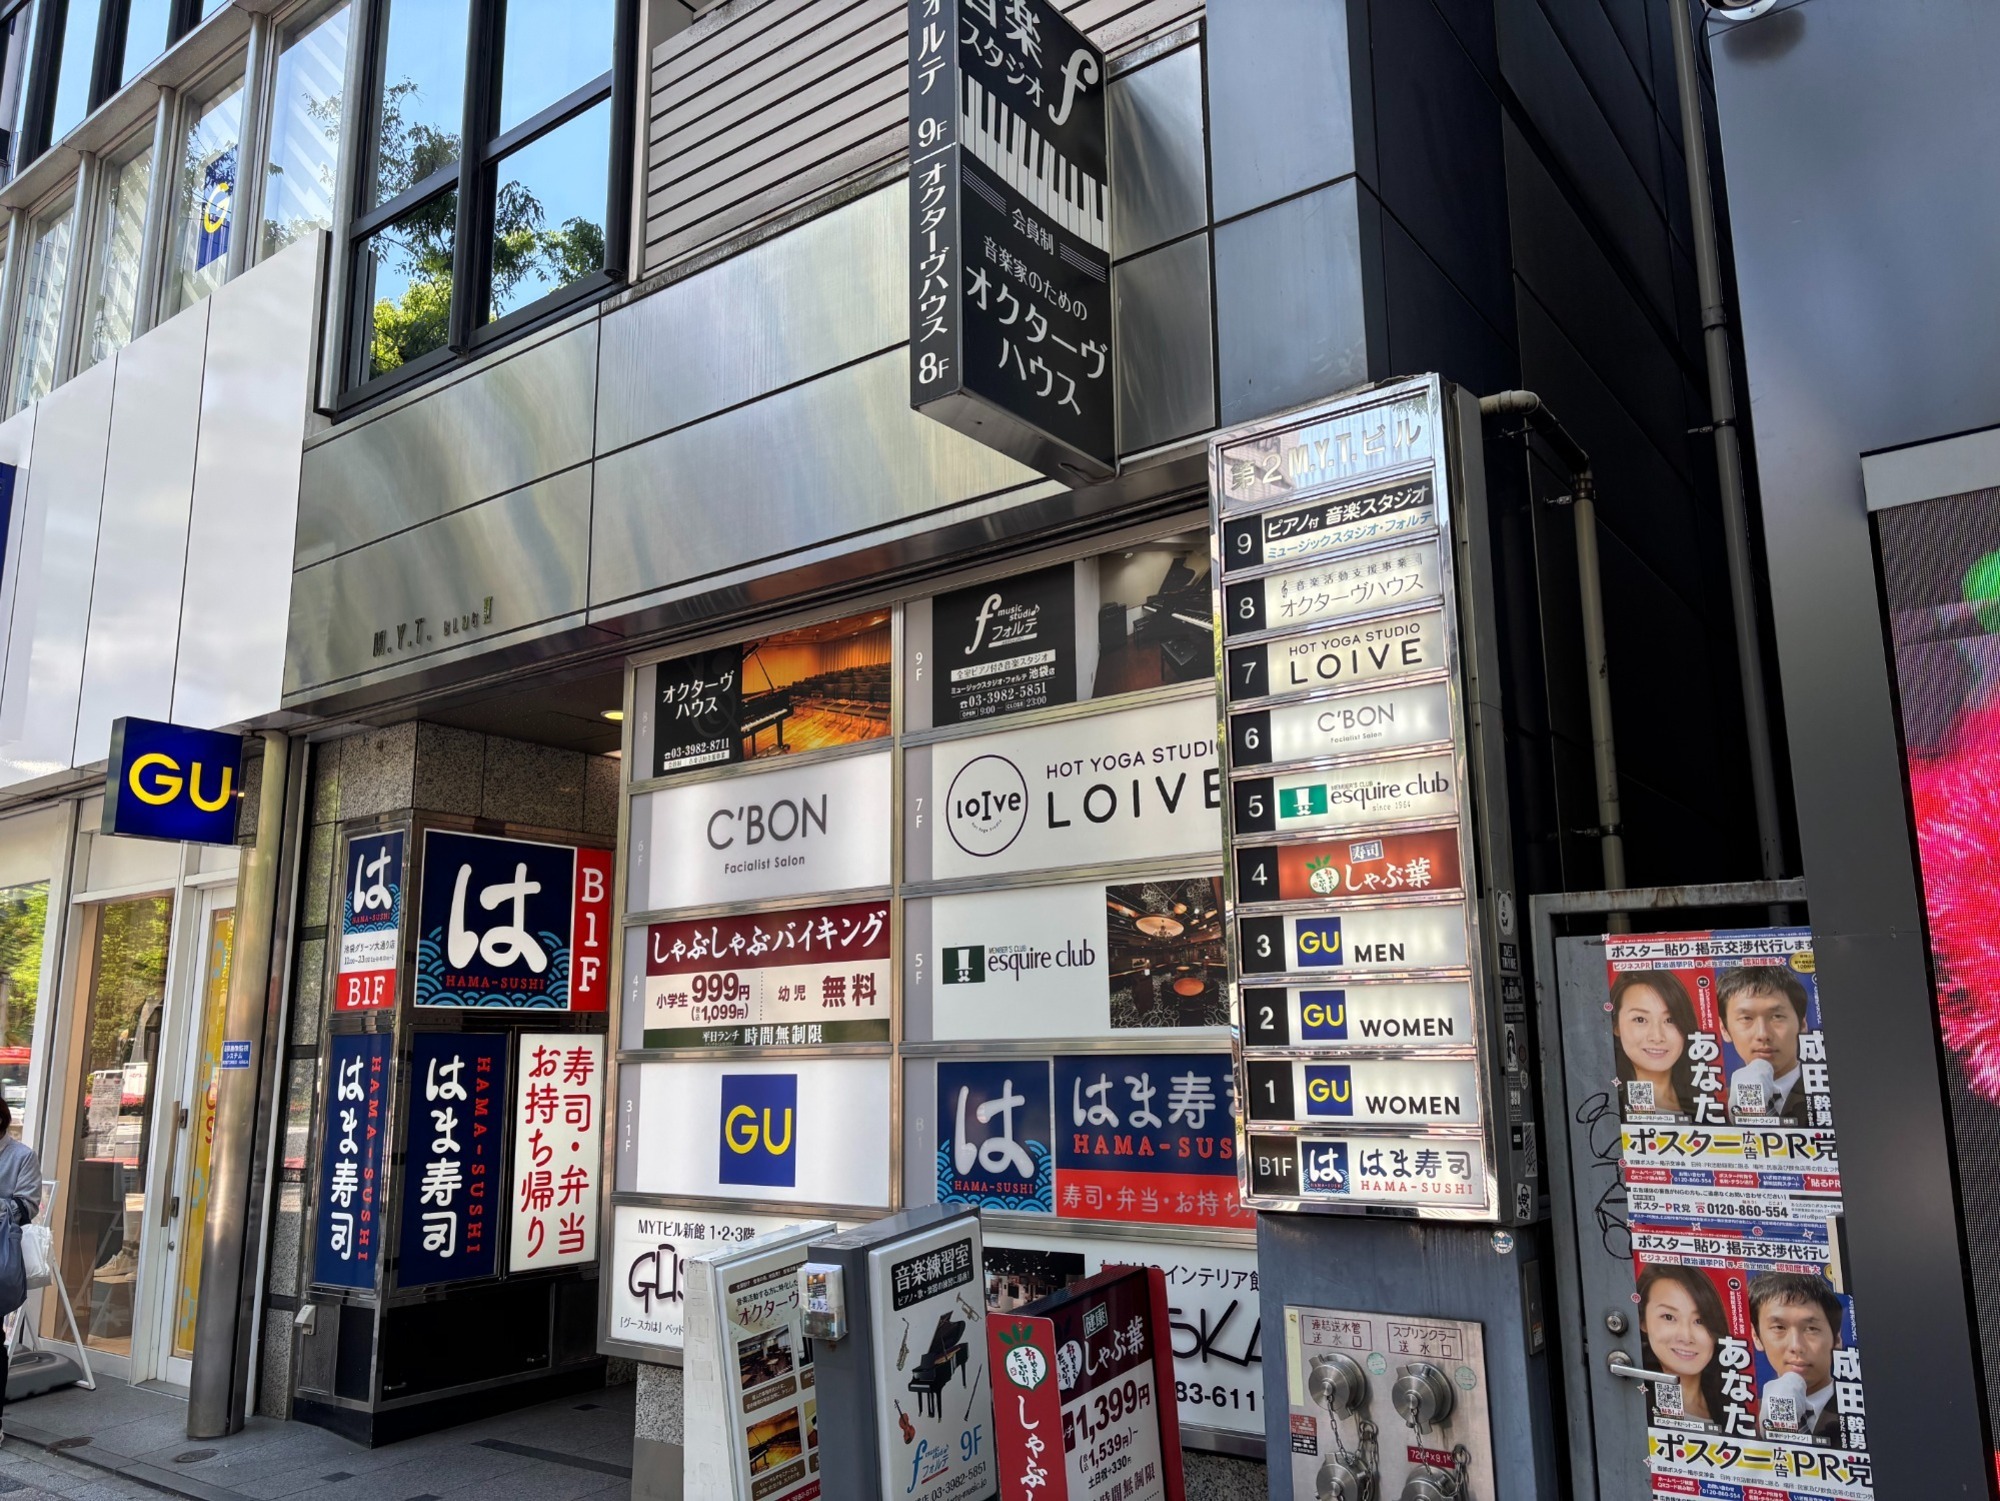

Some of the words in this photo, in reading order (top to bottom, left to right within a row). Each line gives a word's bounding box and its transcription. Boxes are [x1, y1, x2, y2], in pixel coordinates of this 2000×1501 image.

[961, 17, 1044, 107] スタジオ
[918, 118, 947, 148] 9F
[1012, 208, 1054, 256] 会員制
[918, 162, 950, 342] オクターヴハウス
[984, 235, 1088, 321] 音楽家のための
[966, 265, 1108, 378] オクターヴ
[918, 352, 949, 384] 8F
[998, 337, 1081, 415] ハウス
[1237, 533, 1252, 555] 9
[1267, 511, 1432, 559] ミュージックスタジオ・フォルテ
[997, 604, 1023, 616] music
[1239, 597, 1255, 619] 8
[1280, 573, 1424, 618] オクターヴハウス
[992, 618, 1038, 640] フォルテ
[1289, 642, 1316, 656] HOT
[1321, 634, 1361, 651] YOGA
[1365, 622, 1420, 642] STUDIO
[1241, 661, 1257, 685] 7
[1290, 638, 1423, 685] LOIVE
[662, 670, 735, 703] オクターヴ
[968, 682, 1047, 707] 03-3982-5851
[675, 698, 718, 720] ハウス
[1317, 703, 1395, 733] C'BON
[671, 738, 729, 758] 03-3982-8711
[1244, 727, 1260, 750] 6
[1363, 732, 1382, 740] Salon
[1046, 760, 1084, 779] HOT
[1090, 751, 1146, 773] YOGA
[1152, 740, 1221, 764] STUDI
[129, 753, 233, 812] GU
[1331, 781, 1401, 810] esquire
[1405, 771, 1449, 796] club
[707, 794, 827, 850] C'BON
[1248, 794, 1264, 818] 5
[724, 858, 771, 874] Facialist
[774, 855, 806, 869] Salon
[1351, 842, 1381, 862] 寿司
[353, 846, 392, 913] は
[1251, 862, 1268, 886] 4
[1344, 856, 1432, 892] しゃぶ葉
[447, 862, 548, 974] は
[578, 867, 605, 992] B1F
[344, 940, 395, 954] 池袋グリーン大通り店
[654, 910, 887, 964] しゃぶしゃぶバイキング
[1256, 934, 1272, 958] 3
[1299, 931, 1340, 954] GU
[1354, 943, 1405, 963] MEN
[1611, 939, 1813, 958] ポスター貼り・掲示交渉代行します
[987, 946, 1051, 981] esquire
[1056, 939, 1096, 968] club
[1614, 962, 1651, 970] ビジネスPR
[1654, 960, 1694, 969] 政治選挙PR
[347, 975, 386, 1006] B1F
[445, 975, 545, 990] HAMA-SUSHI
[656, 992, 688, 1009] 小学生
[691, 972, 750, 1003] 999円
[778, 985, 806, 1002] 幼児
[822, 972, 877, 1008] 無料
[702, 1029, 740, 1043] 平日ランチ
[744, 1024, 823, 1045] 時間無制限
[1259, 1006, 1275, 1031] 2
[1303, 1003, 1345, 1027] GU
[1360, 1017, 1454, 1037] WOMEN
[1688, 1031, 1726, 1124] あなた
[1799, 1030, 1829, 1095] 成田
[1264, 1079, 1276, 1104] 1
[1308, 1078, 1350, 1102] GU
[1365, 1096, 1461, 1115] WOMEN
[1813, 1095, 1833, 1126] 幹男
[725, 1104, 792, 1155] GU
[954, 1078, 1035, 1178] は
[331, 1055, 365, 1260] はま寿司
[358, 1056, 382, 1260] HAMA-SUSHI
[420, 1055, 467, 1258] はま寿司
[466, 1056, 491, 1253] HAMA-SUSHI
[520, 1045, 561, 1258] お持ち帰り
[557, 1046, 594, 1255] 寿司・弁当
[1258, 1156, 1292, 1176] B1F
[1309, 1147, 1344, 1183] は
[1359, 1148, 1472, 1179] はま寿司
[954, 1180, 1034, 1194] HAMA-SUSHI
[1360, 1180, 1473, 1195] HAMA-SUSHI
[1634, 1201, 1691, 1213] ポスターPR党
[1707, 1202, 1789, 1219] 0120-860-554
[638, 1219, 705, 1240] MYTビル新館
[894, 1243, 970, 1292] 音楽練習室
[1640, 1253, 1680, 1264] ビジネスPR
[1683, 1257, 1724, 1267] 政治選挙PR
[1311, 1319, 1361, 1335] 連結送水管
[1393, 1326, 1456, 1341] スプリンクラー
[1084, 1315, 1144, 1377] しゃぶ葉
[1718, 1335, 1756, 1436] あなた
[1833, 1347, 1866, 1416] 成田
[1076, 1379, 1150, 1445] 1,399円
[960, 1424, 982, 1461] 9F
[1018, 1395, 1048, 1501] しゃぶ
[1847, 1415, 1867, 1450] 幹男
[922, 1454, 949, 1478] フォルテ
[931, 1461, 986, 1500] 03-3982-5851
